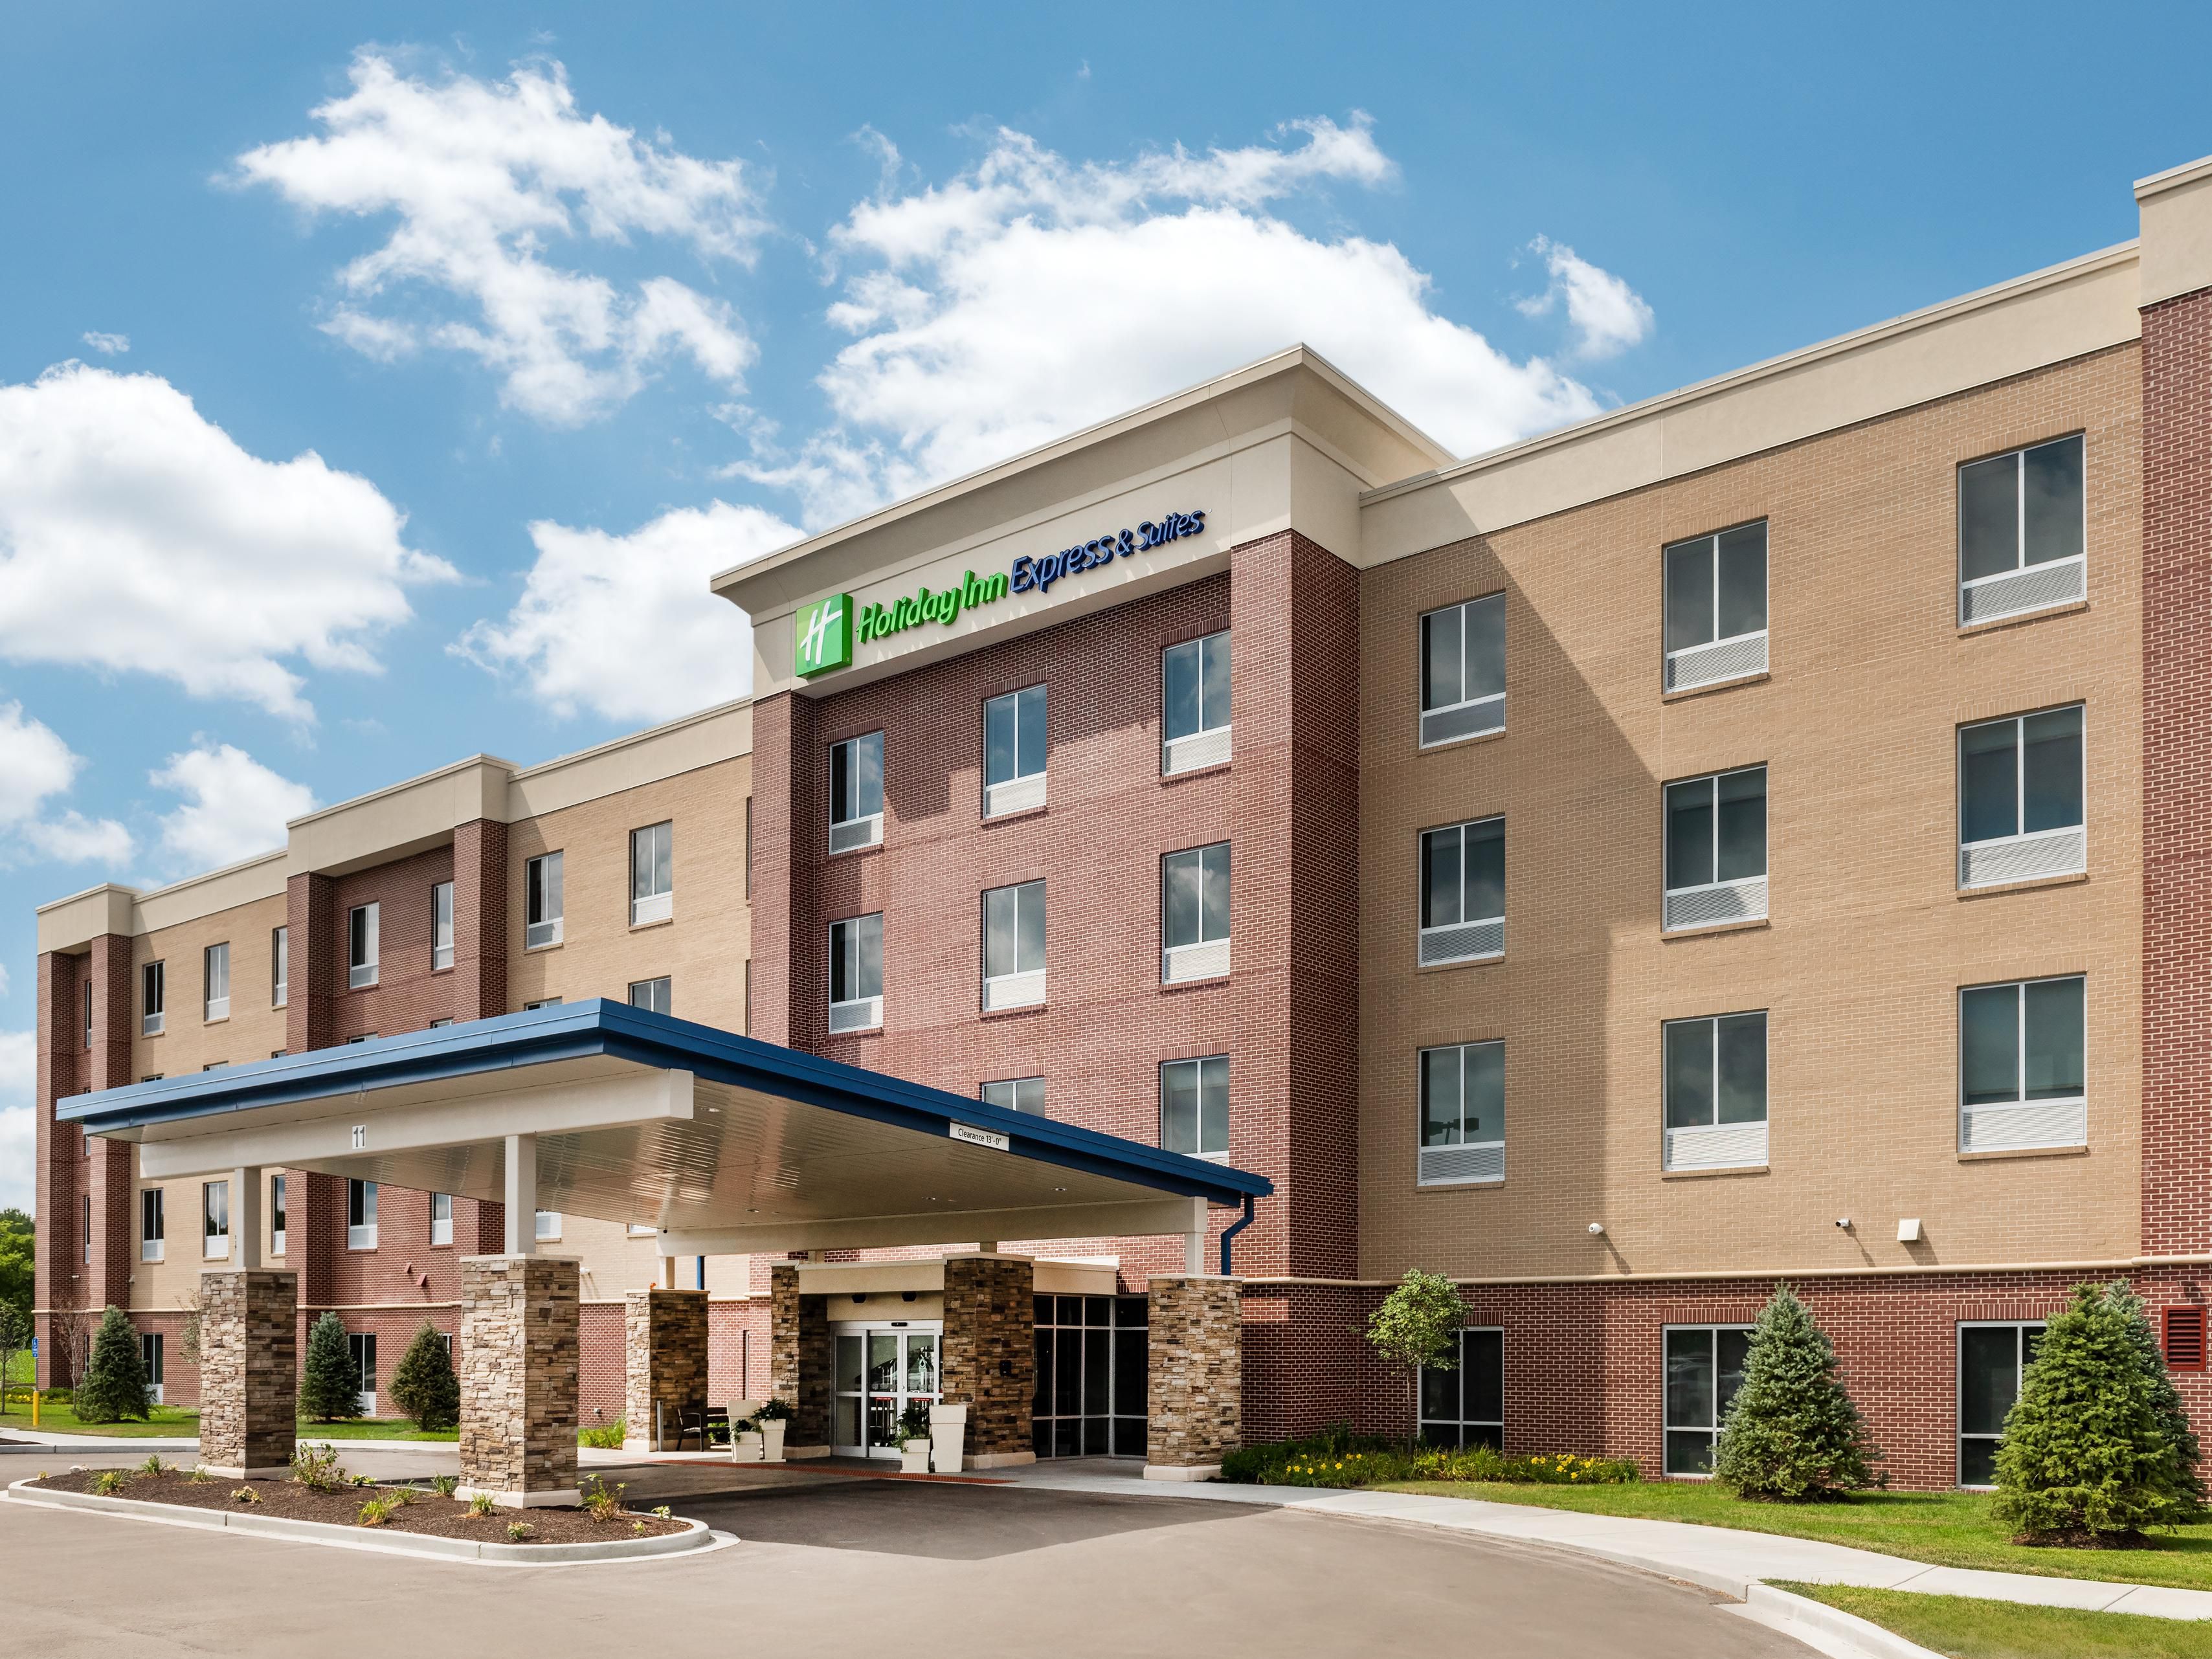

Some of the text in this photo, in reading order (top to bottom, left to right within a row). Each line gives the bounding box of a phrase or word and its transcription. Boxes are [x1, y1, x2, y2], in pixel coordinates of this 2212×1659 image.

[856, 510, 1206, 644] Holiday Inn Express & Suites
[353, 1126, 365, 1148] 11
[957, 1128, 985, 1142] Clearance
